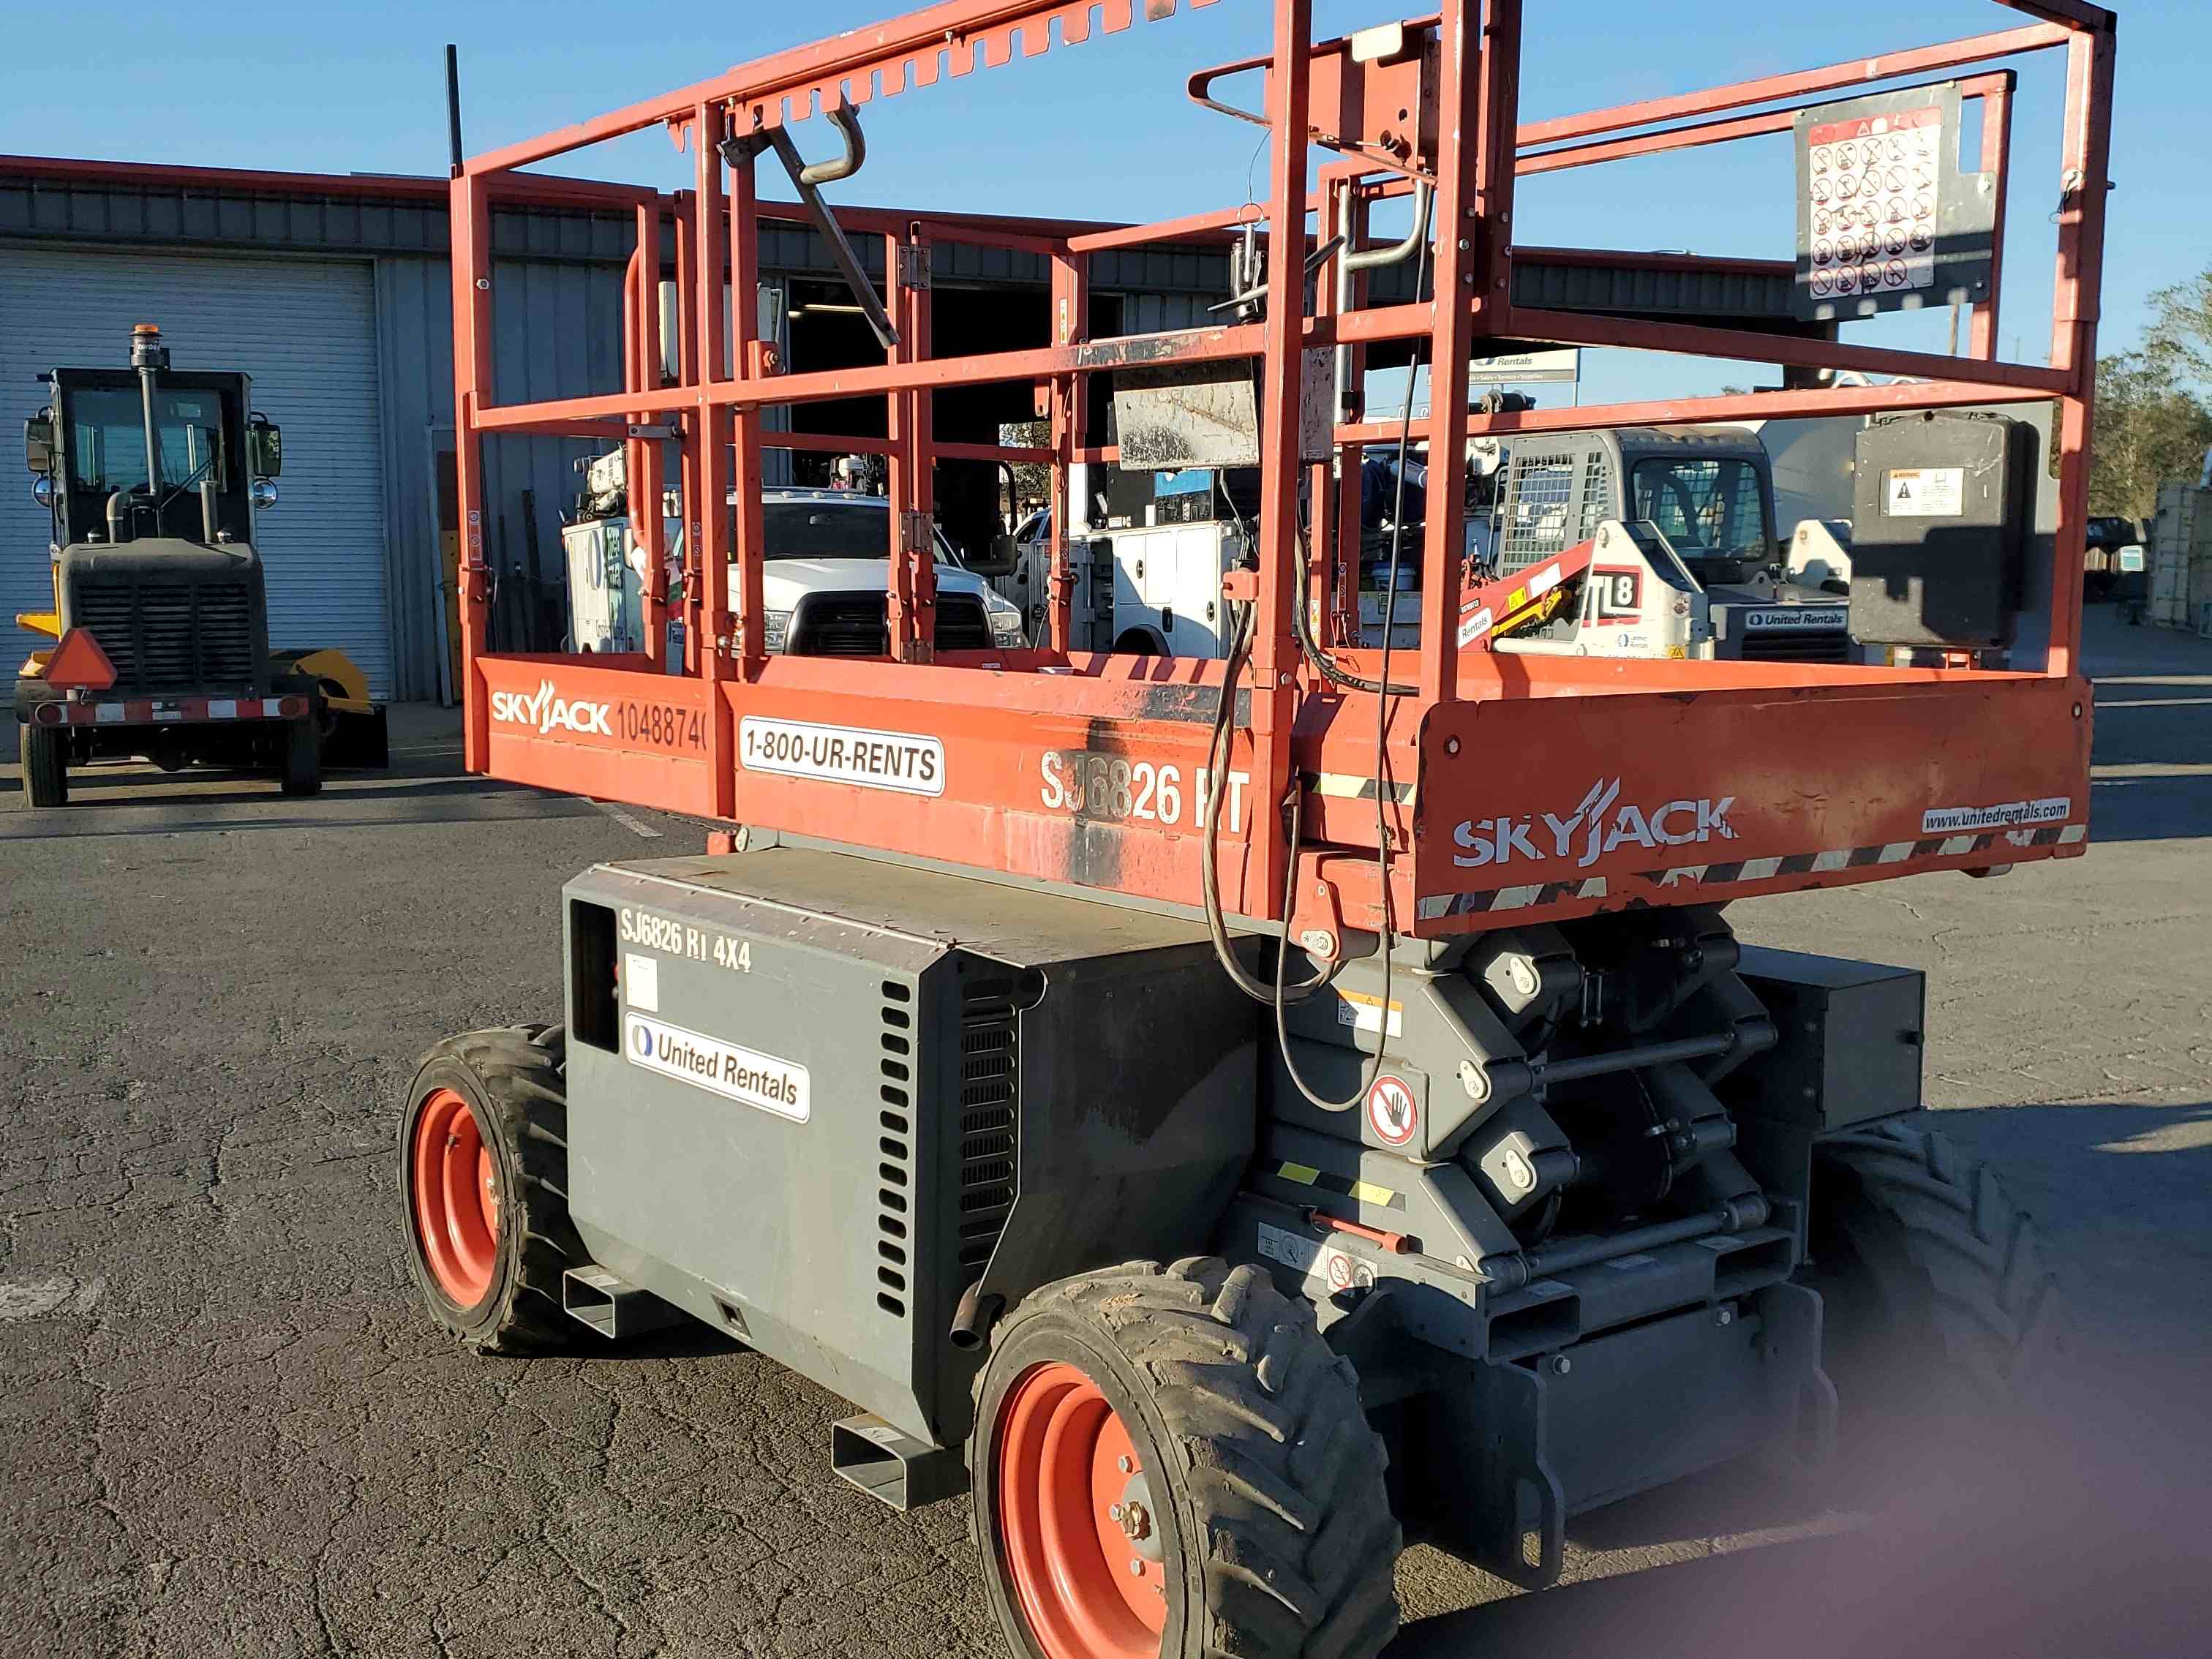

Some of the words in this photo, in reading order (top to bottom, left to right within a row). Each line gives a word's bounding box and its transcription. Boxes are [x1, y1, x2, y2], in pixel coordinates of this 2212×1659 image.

[1497, 357, 1532, 366] Rentals
[1462, 616, 1488, 639] Rentals
[1766, 614, 1802, 625] United
[1803, 614, 1843, 625] Rentals
[492, 678, 613, 736] SKYJACK
[747, 729, 936, 781] 1-800-UR-RENTS
[1453, 776, 1741, 868] SKYJACK
[1925, 802, 2067, 830] www.unitedrentals.com
[621, 908, 682, 955] SJ6826
[658, 1033, 719, 1079] United
[723, 1054, 797, 1106] Rentals
